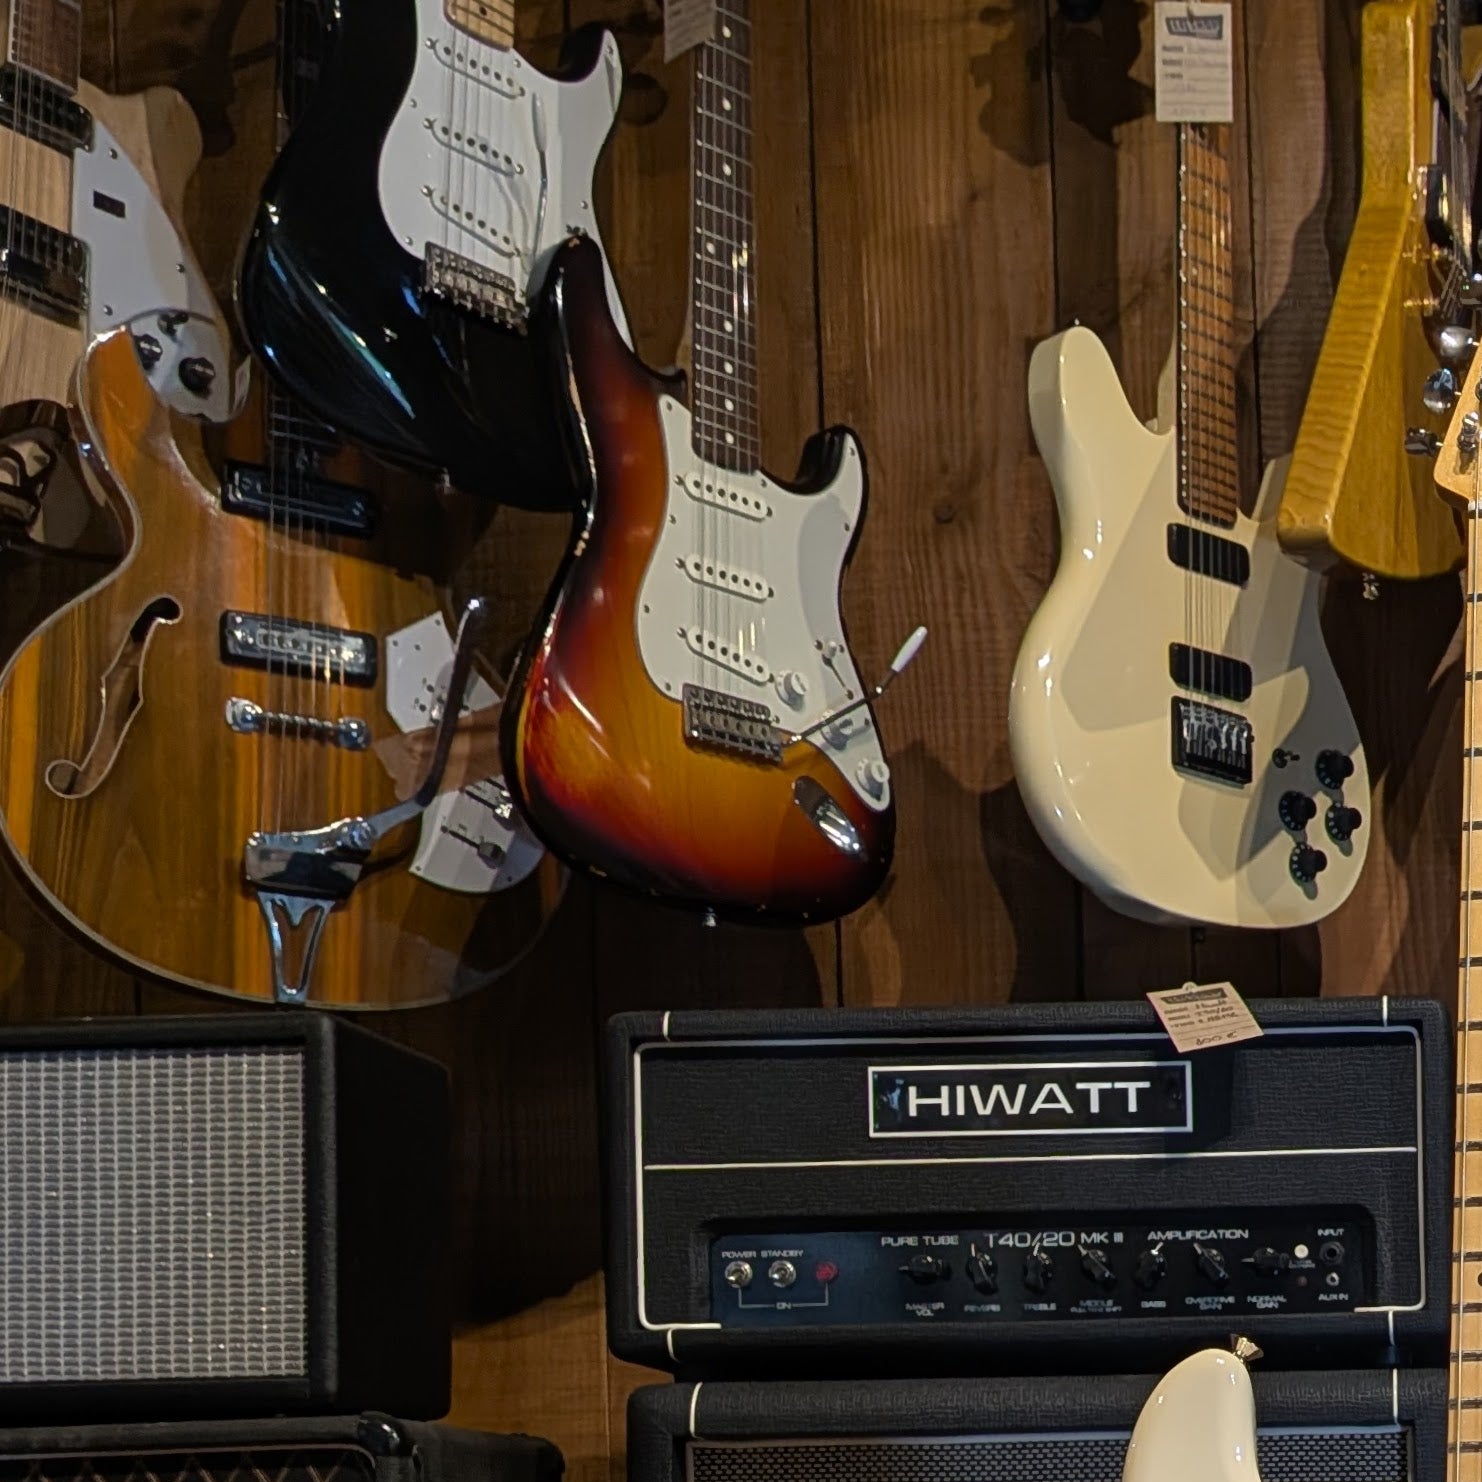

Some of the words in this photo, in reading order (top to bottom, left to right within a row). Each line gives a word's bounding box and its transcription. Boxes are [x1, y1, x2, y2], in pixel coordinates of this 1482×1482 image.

[908, 1081, 1151, 1117] HIWATT
[1147, 1229, 1249, 1241] AMPLIFICATION
[1317, 1228, 1345, 1237] INPUT
[881, 1236, 918, 1247] PURE
[921, 1235, 959, 1246] TUBE
[985, 1231, 1075, 1248] T40/20
[1080, 1231, 1109, 1244] MK
[721, 1251, 757, 1259] POWER
[761, 1249, 804, 1258] STANDBY
[776, 1302, 791, 1310] ON
